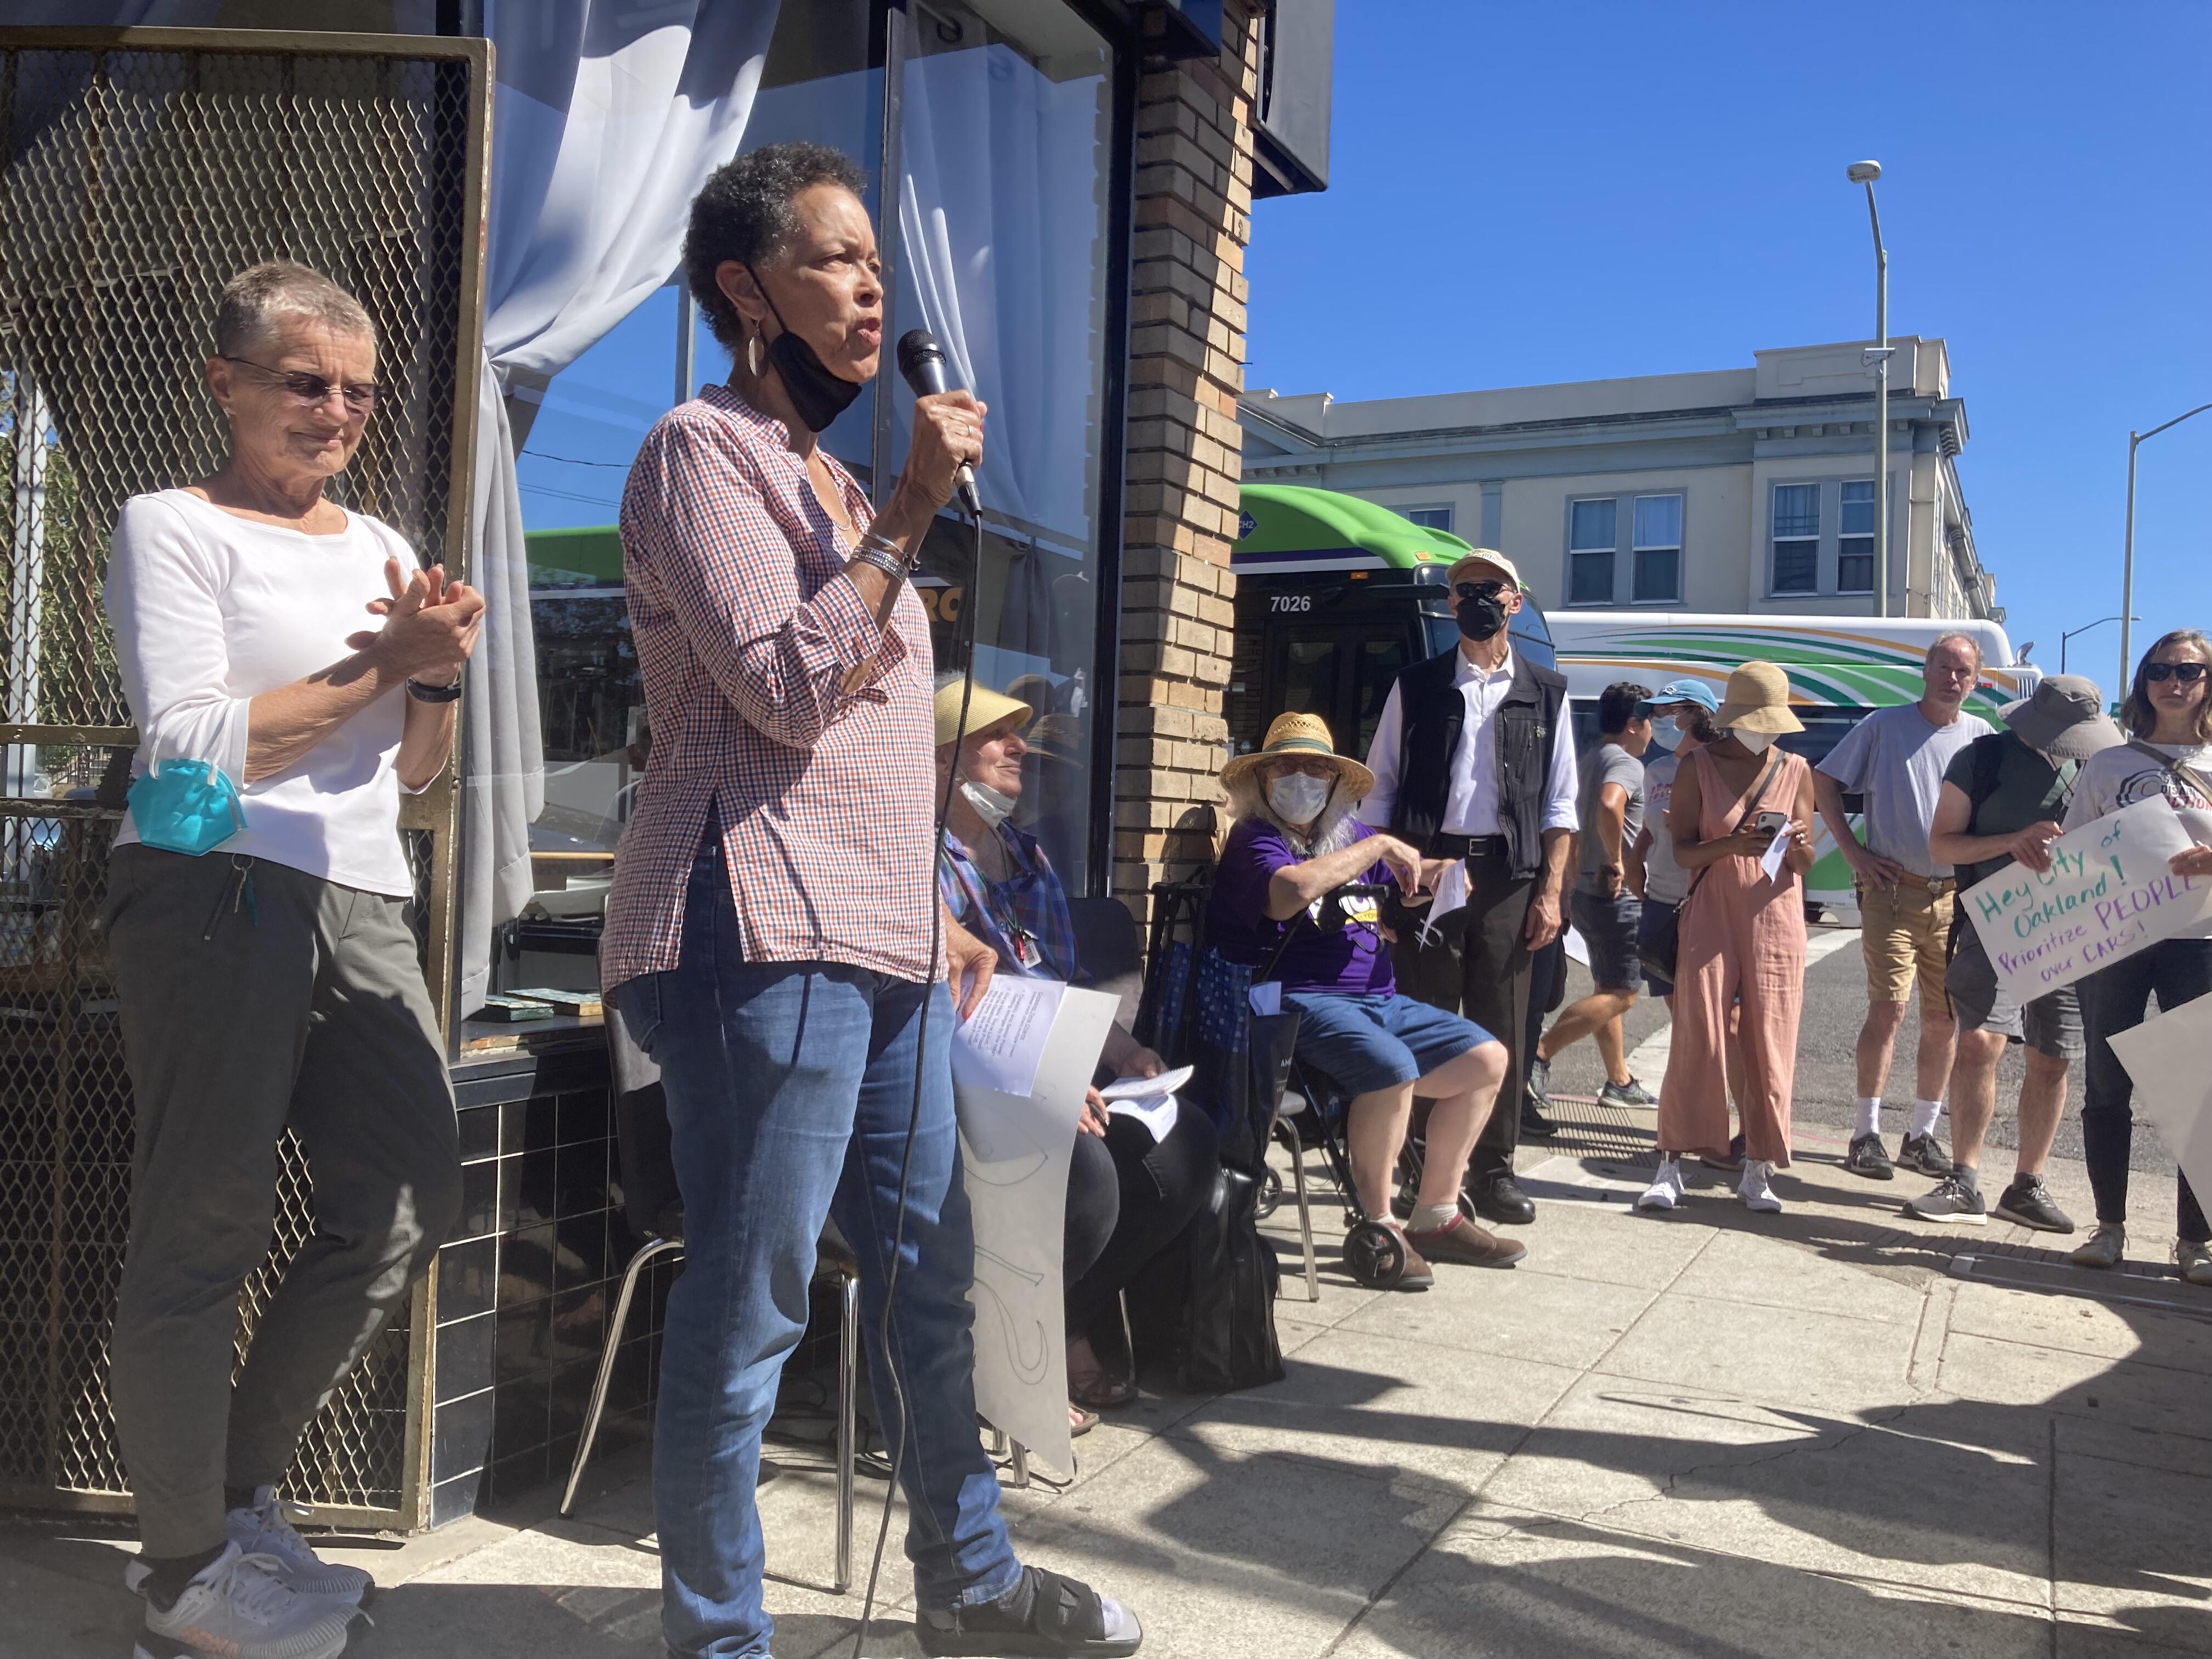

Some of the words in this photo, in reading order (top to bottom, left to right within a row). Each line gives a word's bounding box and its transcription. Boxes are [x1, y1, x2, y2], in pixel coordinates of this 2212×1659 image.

[1271, 595, 1311, 612] 7026
[1976, 881, 2034, 923] Hey
[2101, 820, 2121, 848] of
[1998, 924, 2087, 975] Prioritize
[2095, 874, 2202, 931] PEOPLE
[2041, 956, 2073, 982] over
[2083, 920, 2148, 963] CARS!
